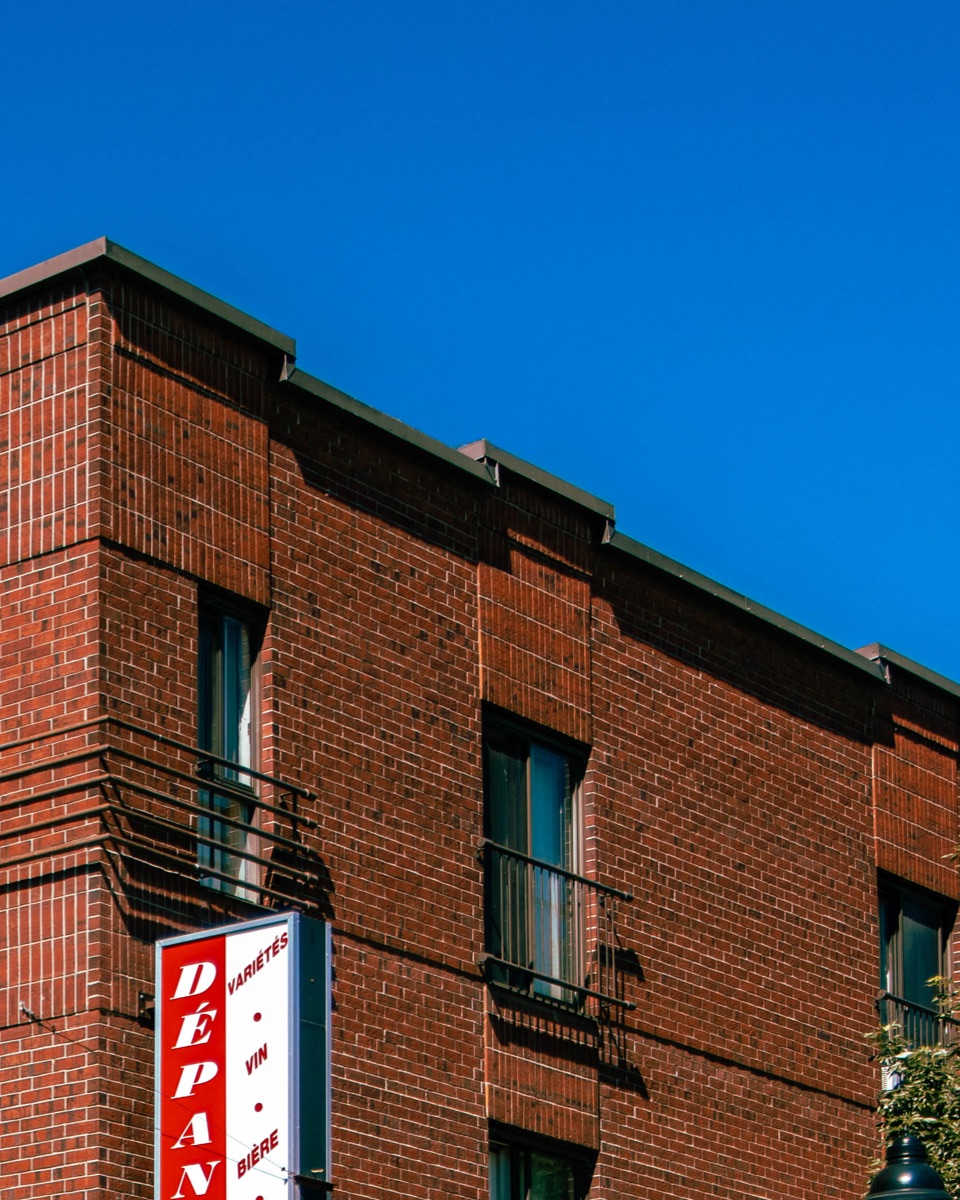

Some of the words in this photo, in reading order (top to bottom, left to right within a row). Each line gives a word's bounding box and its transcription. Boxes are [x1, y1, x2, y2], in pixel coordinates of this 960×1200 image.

[227, 932, 289, 996] VARIÉTÉS
[244, 1043, 268, 1076] VIN
[237, 1129, 279, 1180] BIÈRE
